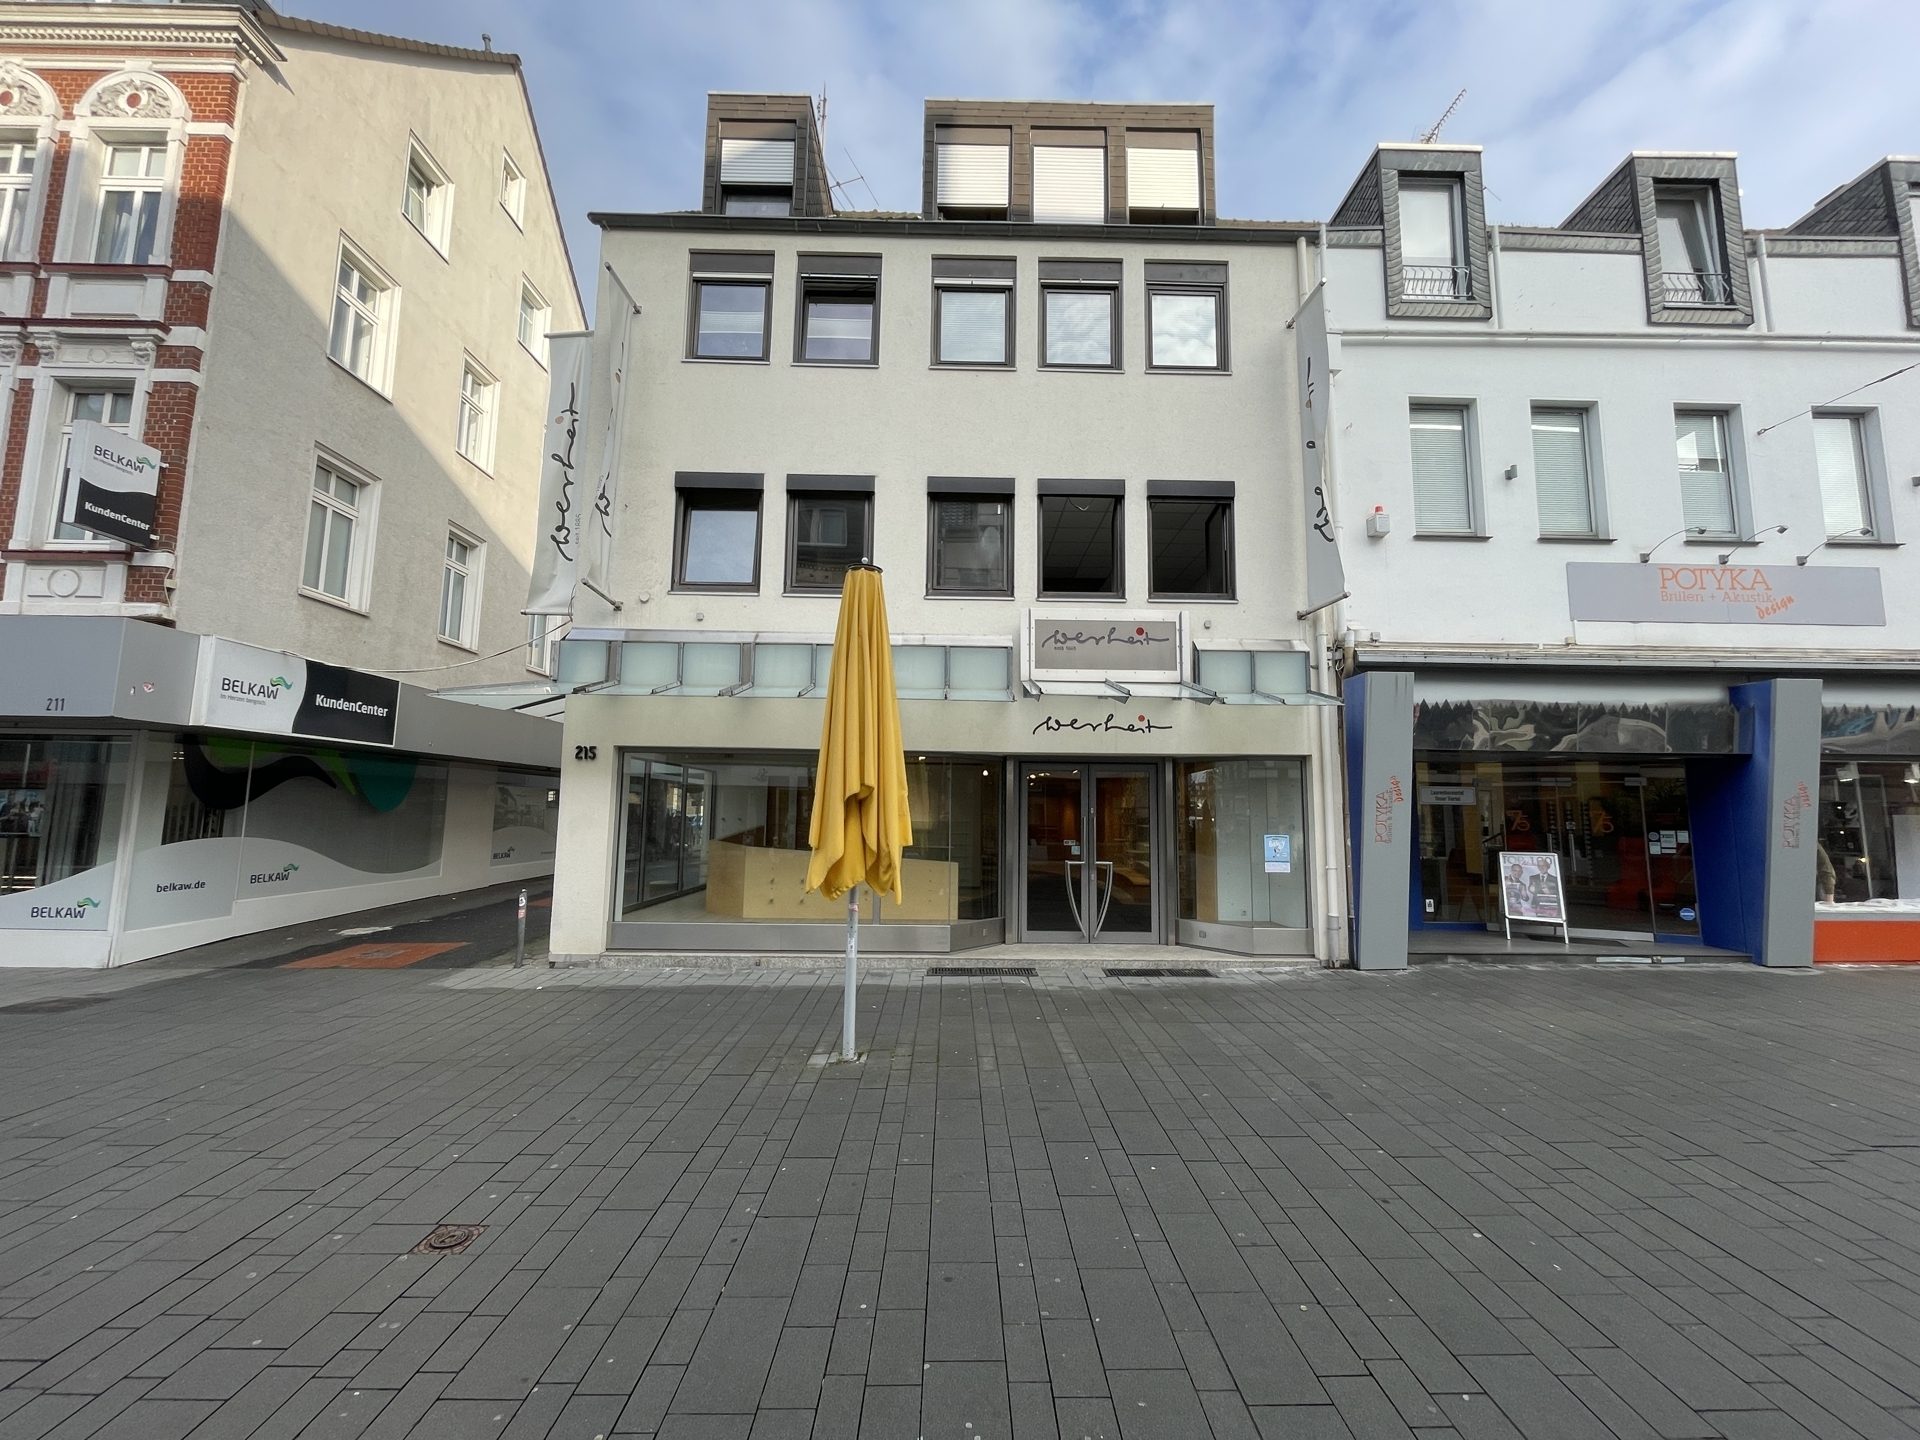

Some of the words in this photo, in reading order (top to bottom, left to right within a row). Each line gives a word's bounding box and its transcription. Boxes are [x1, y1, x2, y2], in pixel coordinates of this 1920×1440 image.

[94, 444, 145, 474] BELKAW
[550, 381, 579, 562] werheit
[84, 501, 151, 531] KundenCenter
[1658, 567, 1773, 591] POTYKA
[1660, 590, 1704, 602] Brillen
[1707, 592, 1716, 600] +
[1041, 627, 1170, 648] werheit
[221, 677, 280, 700] BELKAW
[46, 697, 65, 712] 211
[315, 693, 389, 717] KundenCenter
[1033, 713, 1173, 735] werheit
[574, 745, 597, 760] 215
[1375, 791, 1388, 843] POTYKA
[156, 880, 206, 893] belkaw.de
[250, 872, 290, 885] BELKAW
[30, 906, 86, 919] BELKAW
